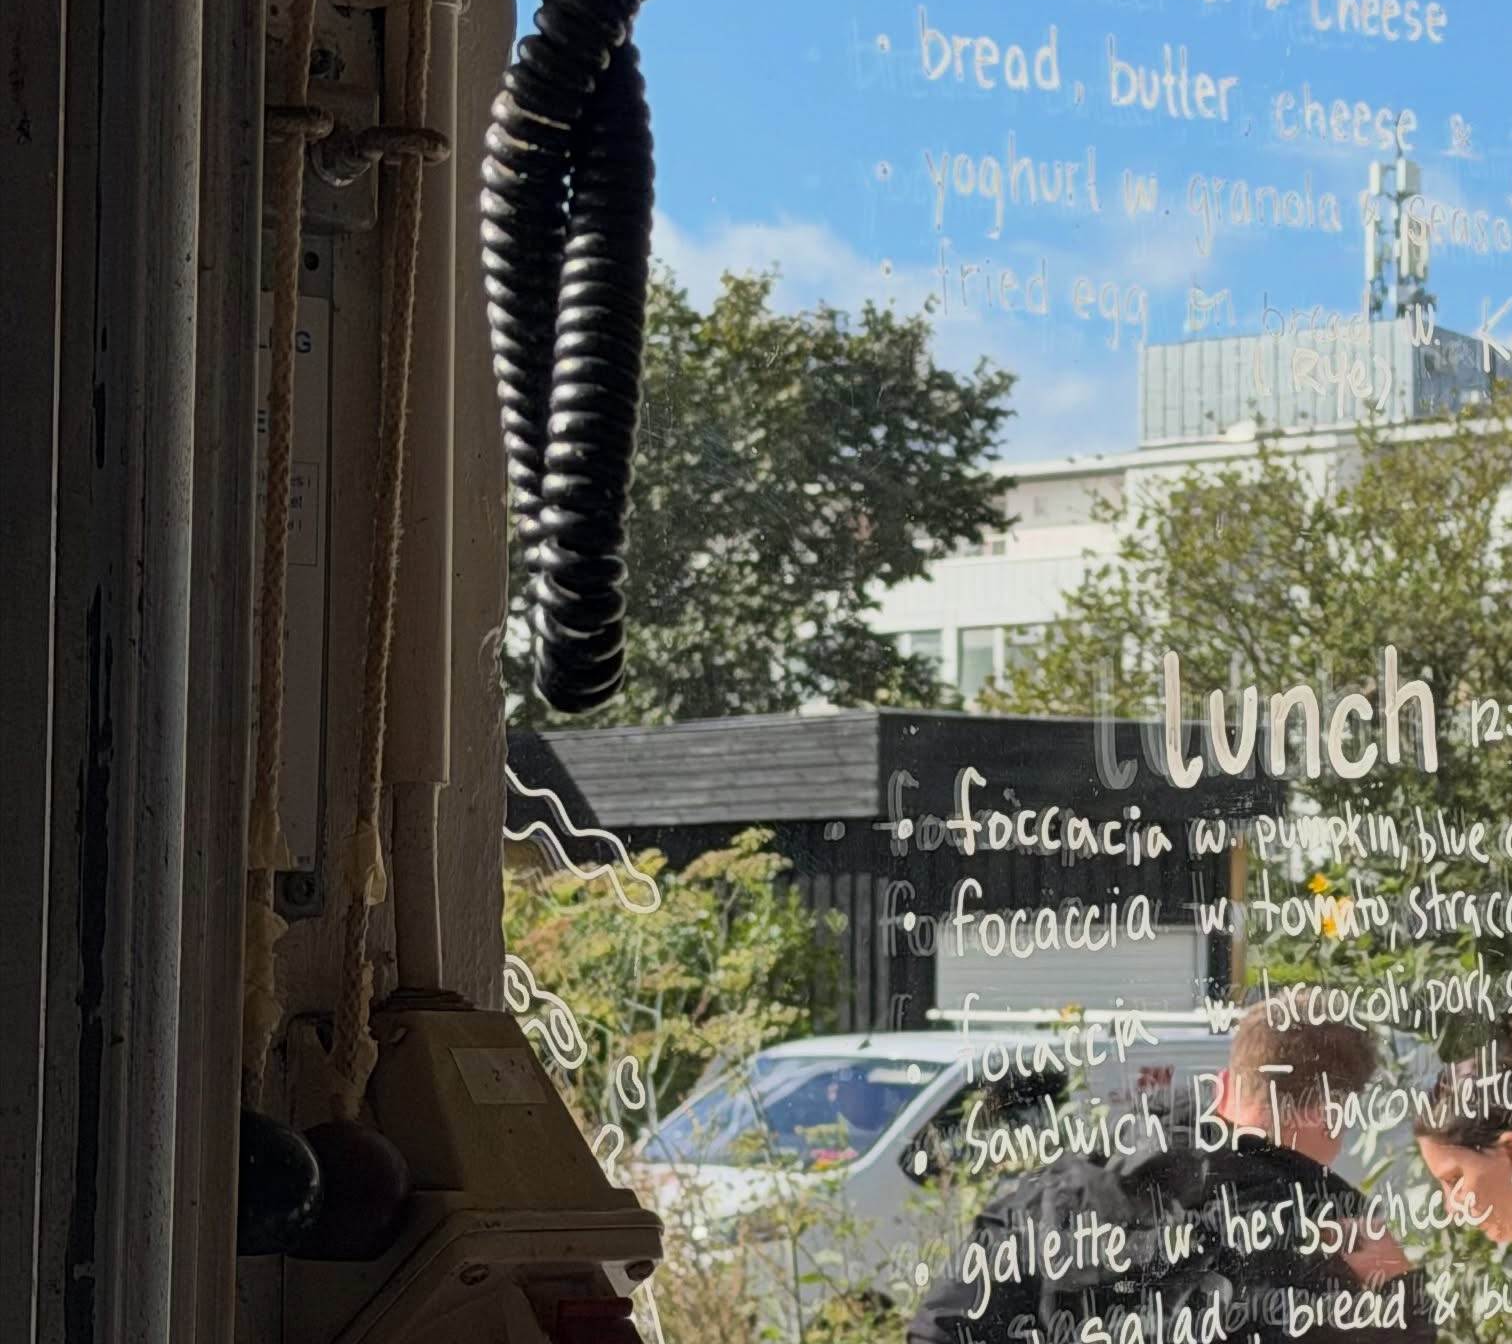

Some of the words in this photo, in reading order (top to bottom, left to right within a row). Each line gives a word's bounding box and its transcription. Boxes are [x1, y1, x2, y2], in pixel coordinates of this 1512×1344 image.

[1274, 81, 1419, 153] cheese
[923, 130, 1103, 241] yoghurt
[1188, 171, 1344, 256] granola
[1072, 274, 1149, 351] egg
[1262, 283, 1374, 348] bread
[1163, 644, 1439, 790] lunch
[946, 766, 1174, 866] foccacia
[1415, 805, 1490, 864] blue
[952, 877, 1157, 959] focaccia
[955, 992, 1160, 1084] focaccia
[1428, 952, 1497, 1040] pork
[961, 1210, 1135, 1320] galette
[1367, 1178, 1496, 1241] cheese
[1287, 1278, 1409, 1337] bread
